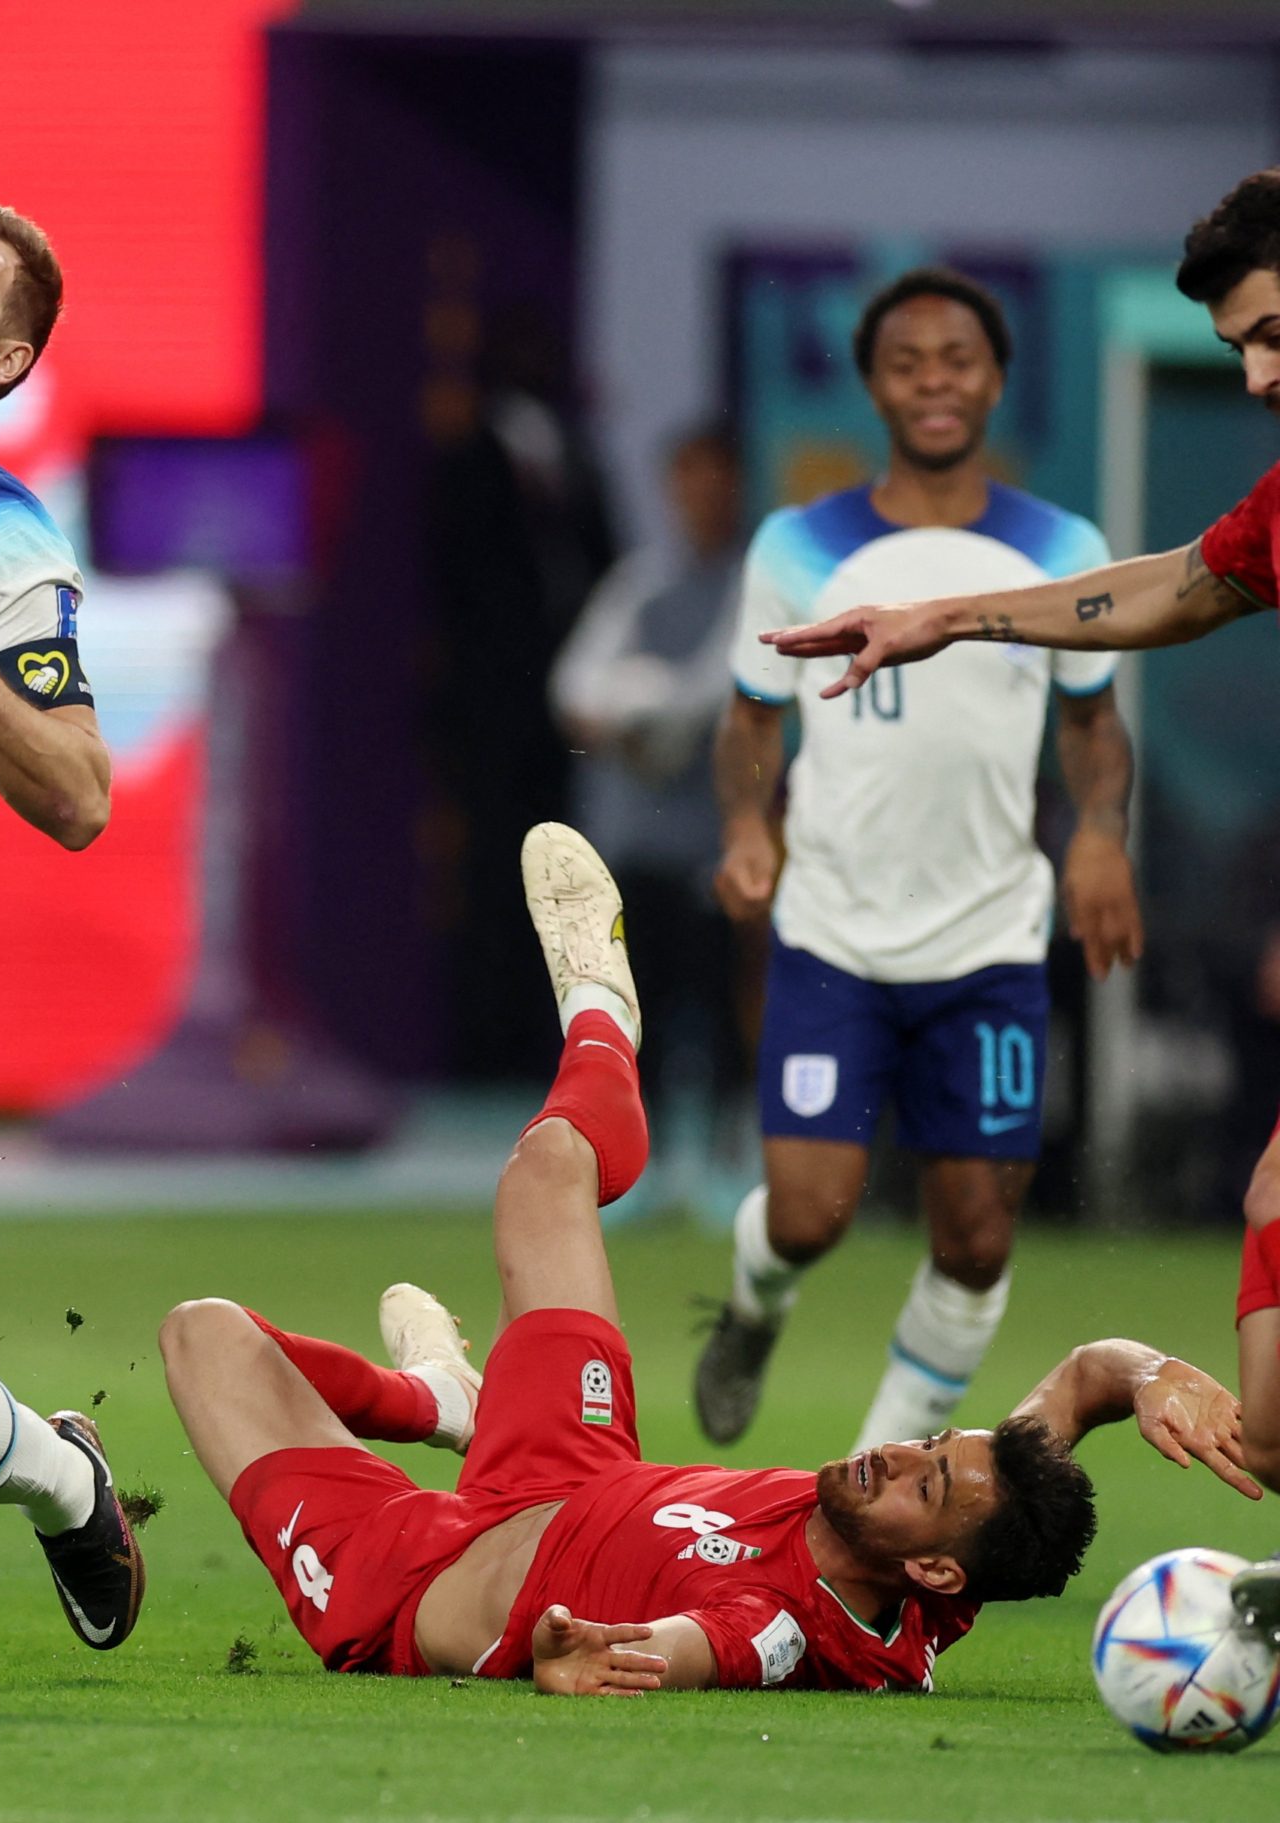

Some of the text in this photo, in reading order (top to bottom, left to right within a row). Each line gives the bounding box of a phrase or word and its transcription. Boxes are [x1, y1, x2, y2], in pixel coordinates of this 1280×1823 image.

[847, 653, 902, 720] 10
[975, 1021, 1035, 1109] 10
[653, 1503, 736, 1535] 8
